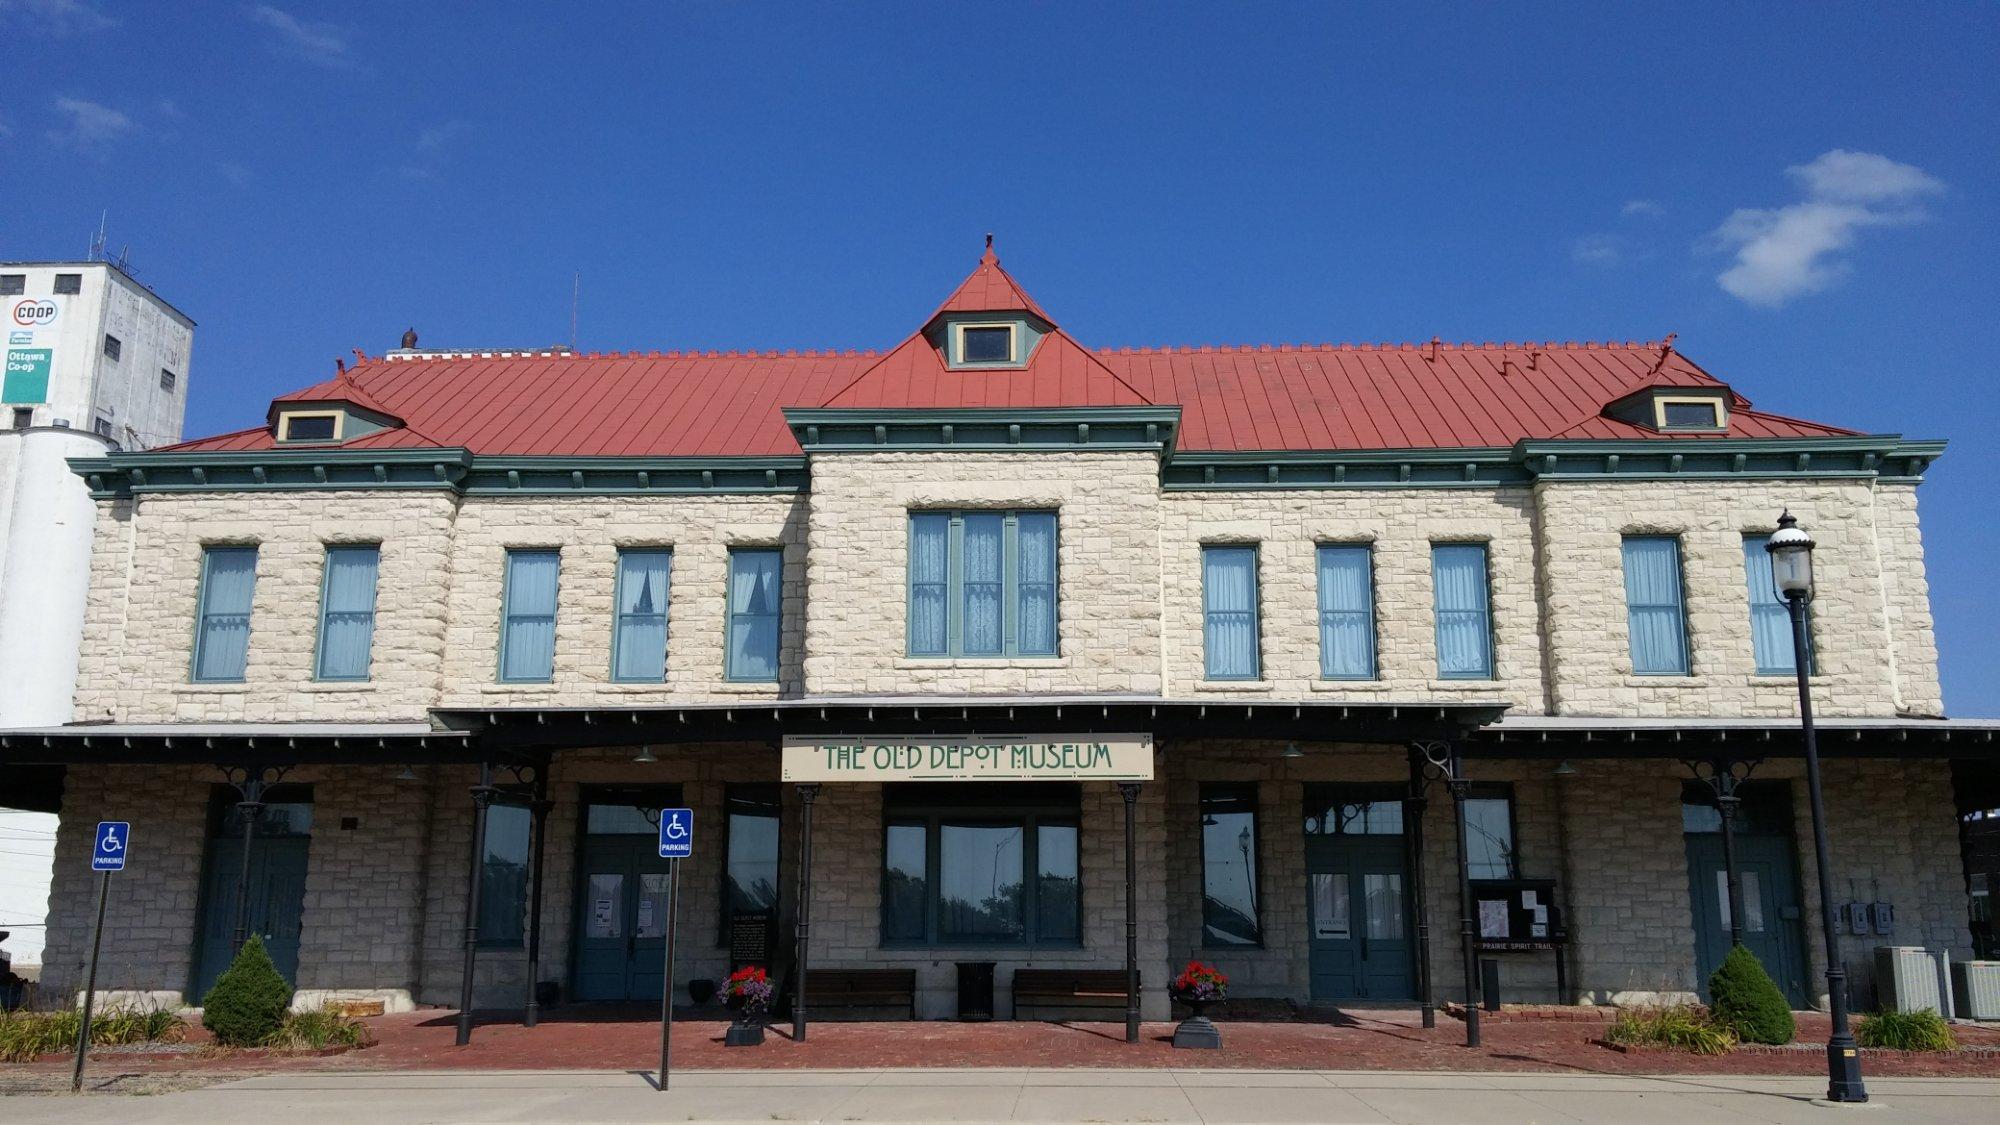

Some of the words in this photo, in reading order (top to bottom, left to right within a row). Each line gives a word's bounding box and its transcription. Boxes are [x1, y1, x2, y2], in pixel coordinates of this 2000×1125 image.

[18, 307, 54, 318] COOP
[9, 352, 45, 361] Ottawa
[8, 362, 35, 372] Co-op
[823, 745, 866, 770] THE
[873, 745, 922, 770] OLD
[930, 745, 1001, 769] DEPOT
[1011, 744, 1112, 769] MUSEUM
[661, 843, 690, 852] PARKING
[94, 857, 123, 865] PARKING
[1482, 942, 1508, 950] PRAIRIE
[1511, 942, 1531, 950] SPIRIT
[1535, 942, 1553, 950] TRAIL
